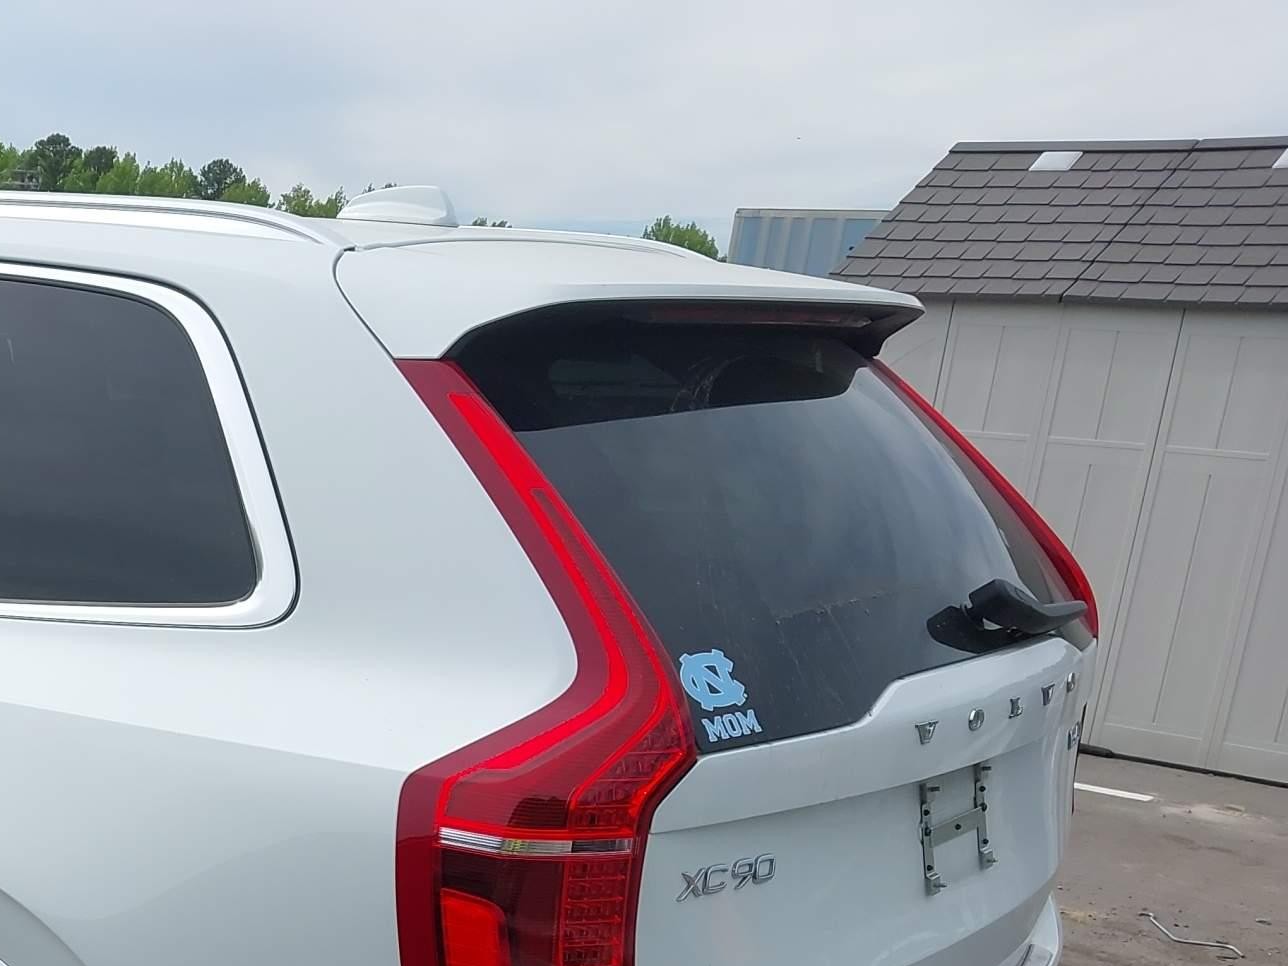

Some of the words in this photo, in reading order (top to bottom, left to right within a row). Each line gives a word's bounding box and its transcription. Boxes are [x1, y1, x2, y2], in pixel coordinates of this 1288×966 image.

[701, 709, 763, 742] MOM
[915, 672, 1076, 745] VOLVO
[676, 853, 777, 902] XC90
